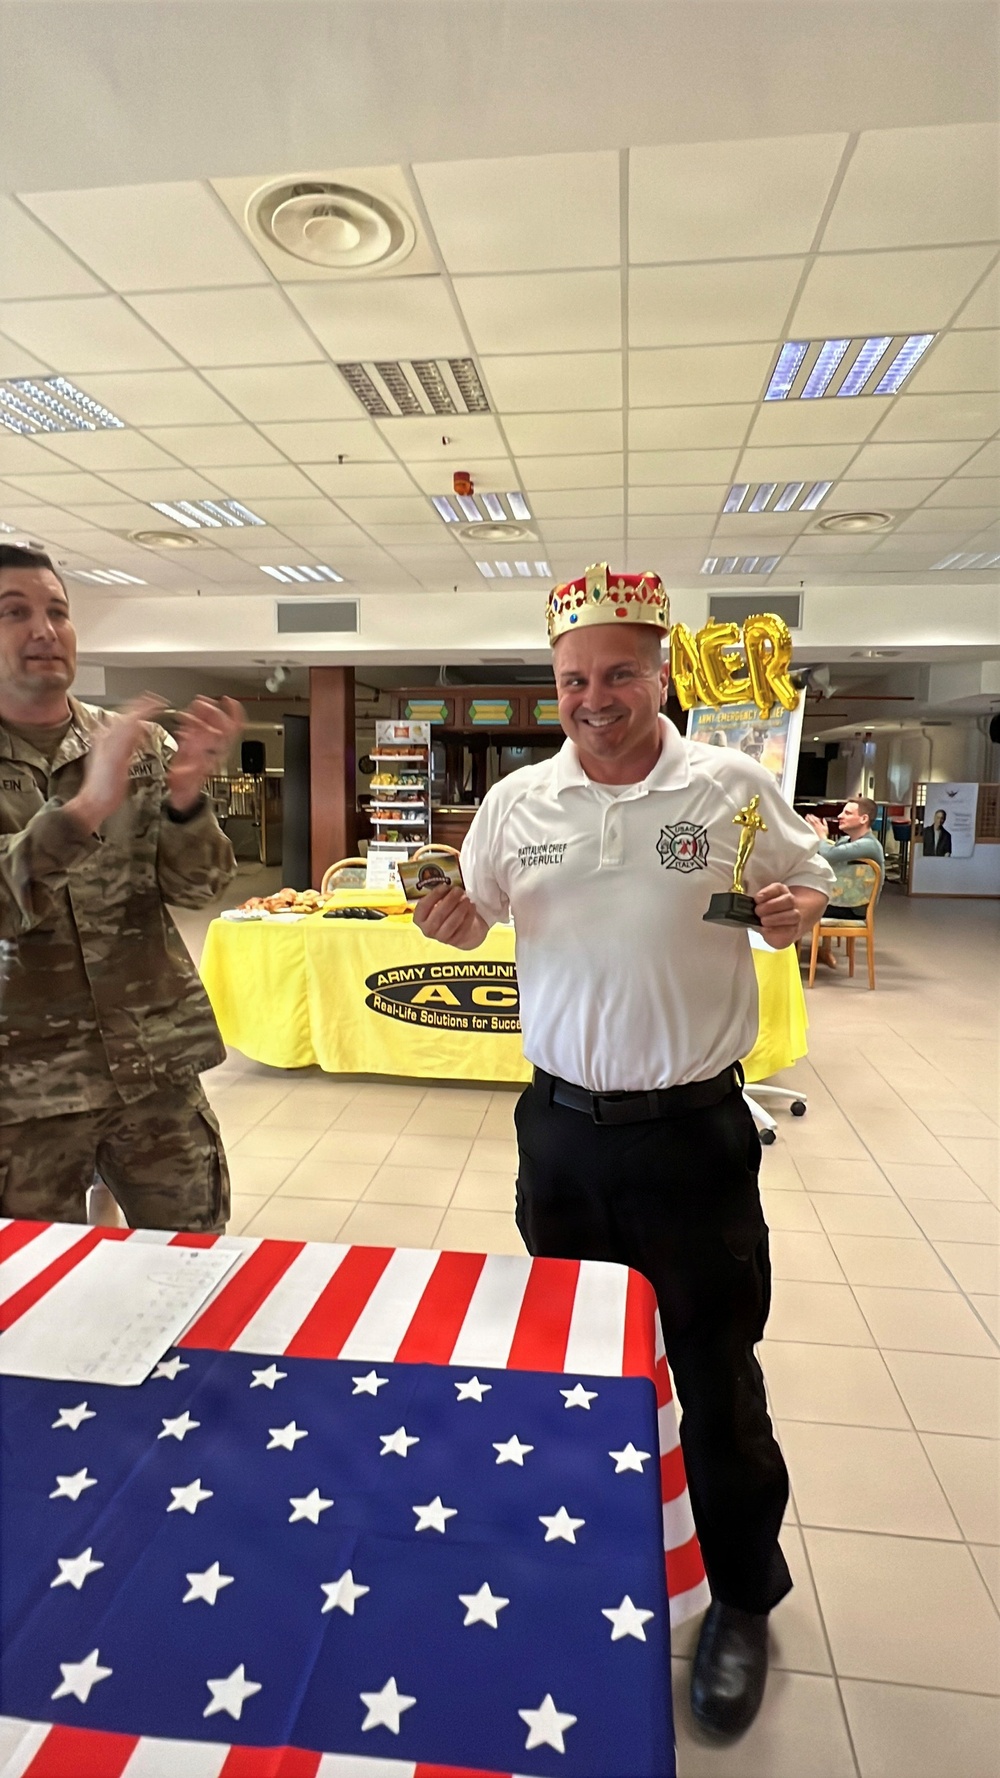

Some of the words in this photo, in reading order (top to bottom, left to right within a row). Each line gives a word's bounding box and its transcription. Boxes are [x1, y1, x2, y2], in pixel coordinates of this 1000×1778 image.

[698, 713, 715, 724] ARMY
[718, 709, 757, 722] EMERGENCY
[518, 844, 548, 858] BATTALION
[548, 843, 567, 853] CHIEF
[527, 854, 563, 867] CERULLI
[377, 967, 426, 986] ARMY
[430, 965, 517, 978] COMMUNI
[373, 995, 417, 1021] Real-Life
[420, 1010, 469, 1028] Solutions
[472, 1016, 488, 1029] for
